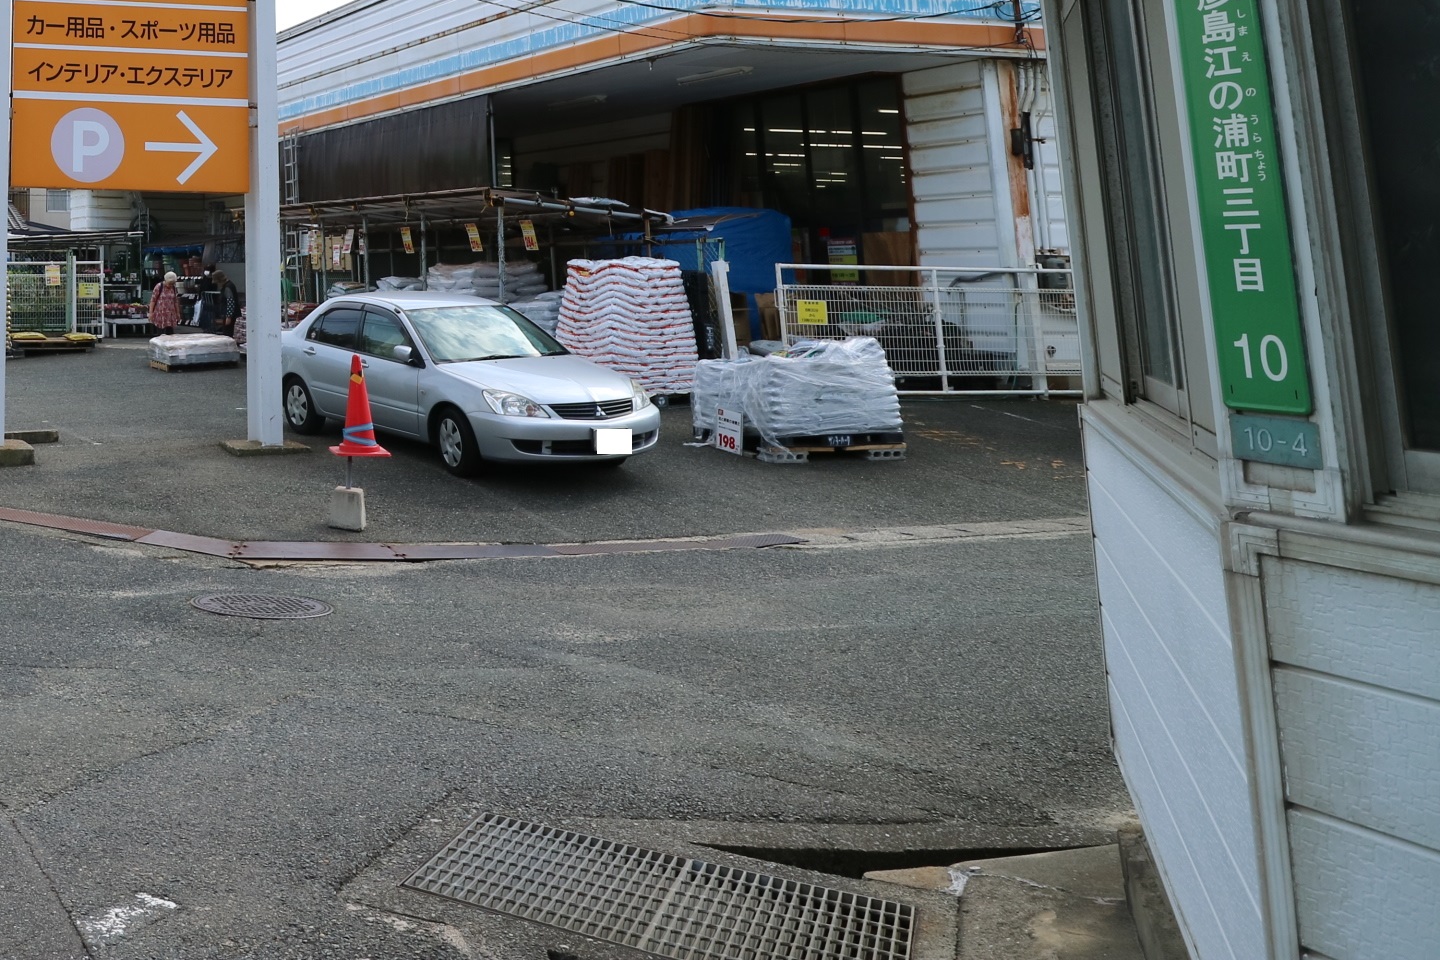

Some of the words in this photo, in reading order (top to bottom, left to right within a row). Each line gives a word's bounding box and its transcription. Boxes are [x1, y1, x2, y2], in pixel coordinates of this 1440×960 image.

[27, 14, 236, 45] カー用品・スポーツ用品
[28, 60, 233, 88] インテリア・エクステリア
[72, 120, 110, 173] P
[1233, 332, 1288, 382] 10
[718, 433, 735, 450] 198
[1244, 426, 1308, 457] 10-4
